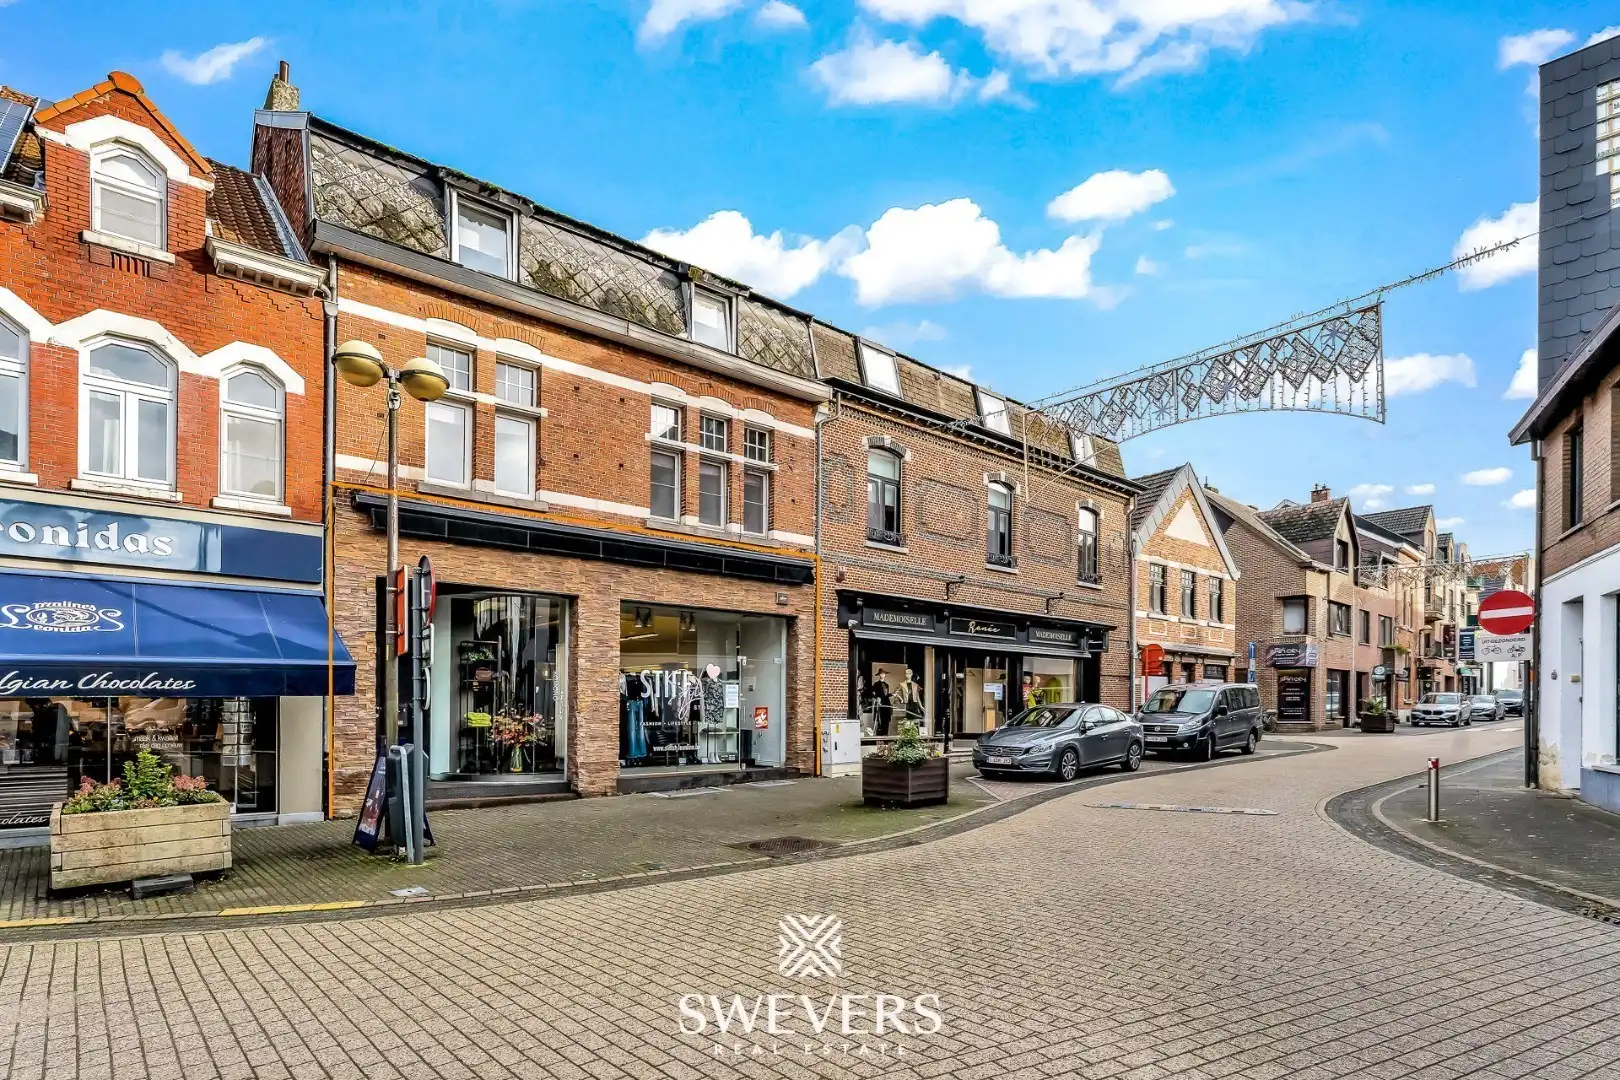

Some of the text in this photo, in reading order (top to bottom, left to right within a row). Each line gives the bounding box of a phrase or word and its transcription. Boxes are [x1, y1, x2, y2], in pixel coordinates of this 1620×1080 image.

[0, 521, 174, 556] onidas
[873, 612, 927, 626] MADEMOISELLE
[1035, 630, 1073, 641] MADEMOISELLE
[1481, 637, 1526, 645] UITGEZONDERD
[77, 671, 196, 690] Chocolates
